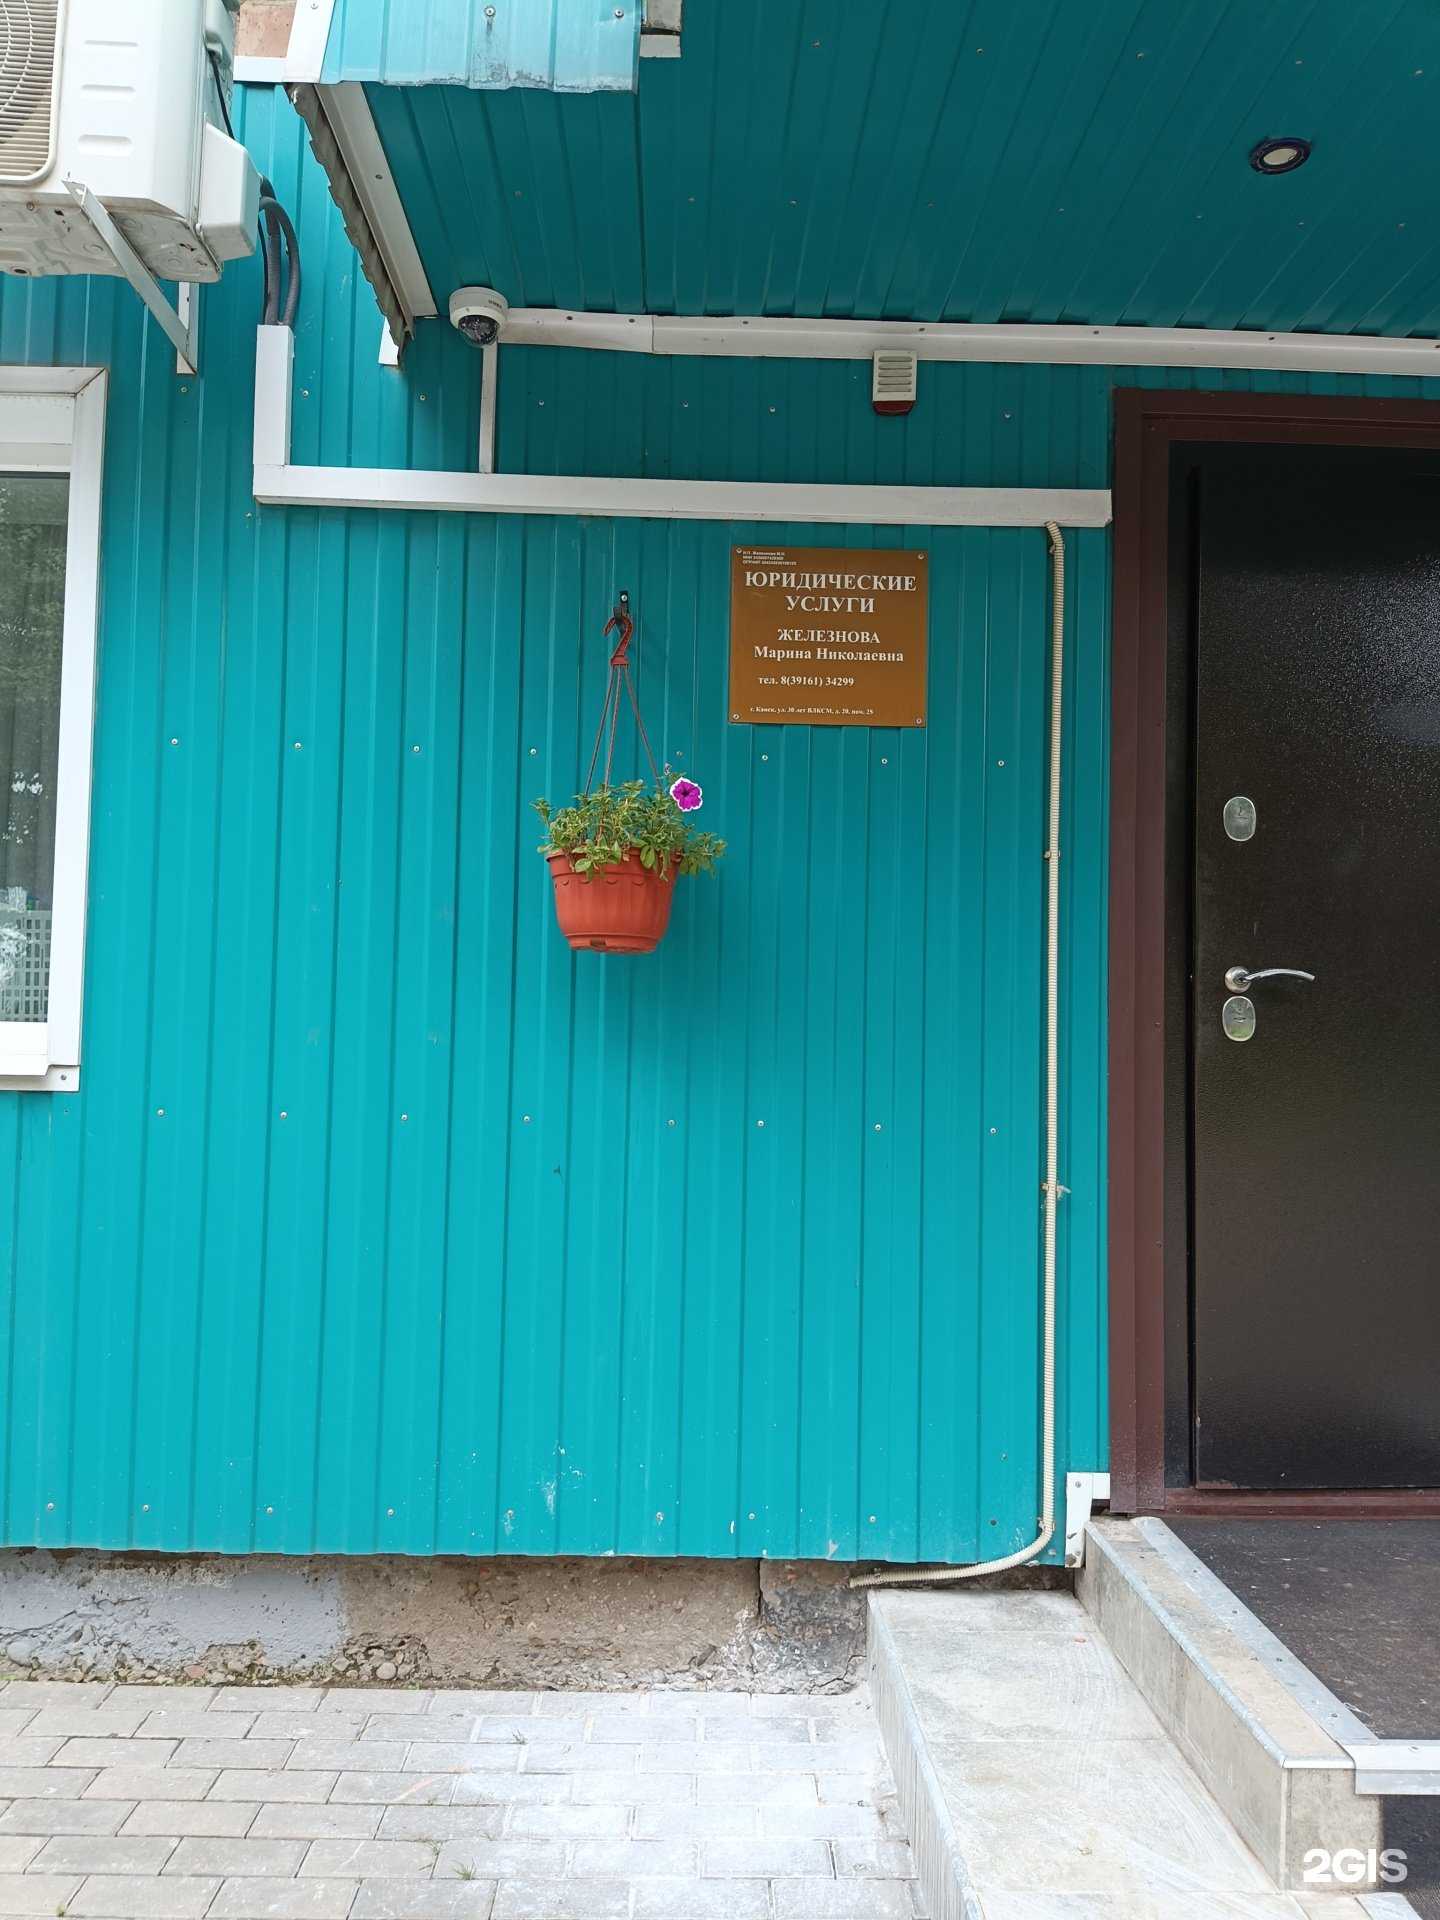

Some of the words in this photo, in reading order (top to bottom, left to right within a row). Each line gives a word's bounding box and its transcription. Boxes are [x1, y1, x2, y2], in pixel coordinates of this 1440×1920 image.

[744, 571, 917, 592] ЮРИДИЧЕСКИЕ
[785, 595, 875, 613] УСЛУГИ
[777, 628, 881, 644] ЖЕЛЕЗНОВА
[753, 645, 812, 662] Марина
[816, 647, 904, 662] Николаевна
[758, 676, 778, 685] тел.
[780, 675, 823, 687] 8(39161)
[825, 676, 855, 687] 34299
